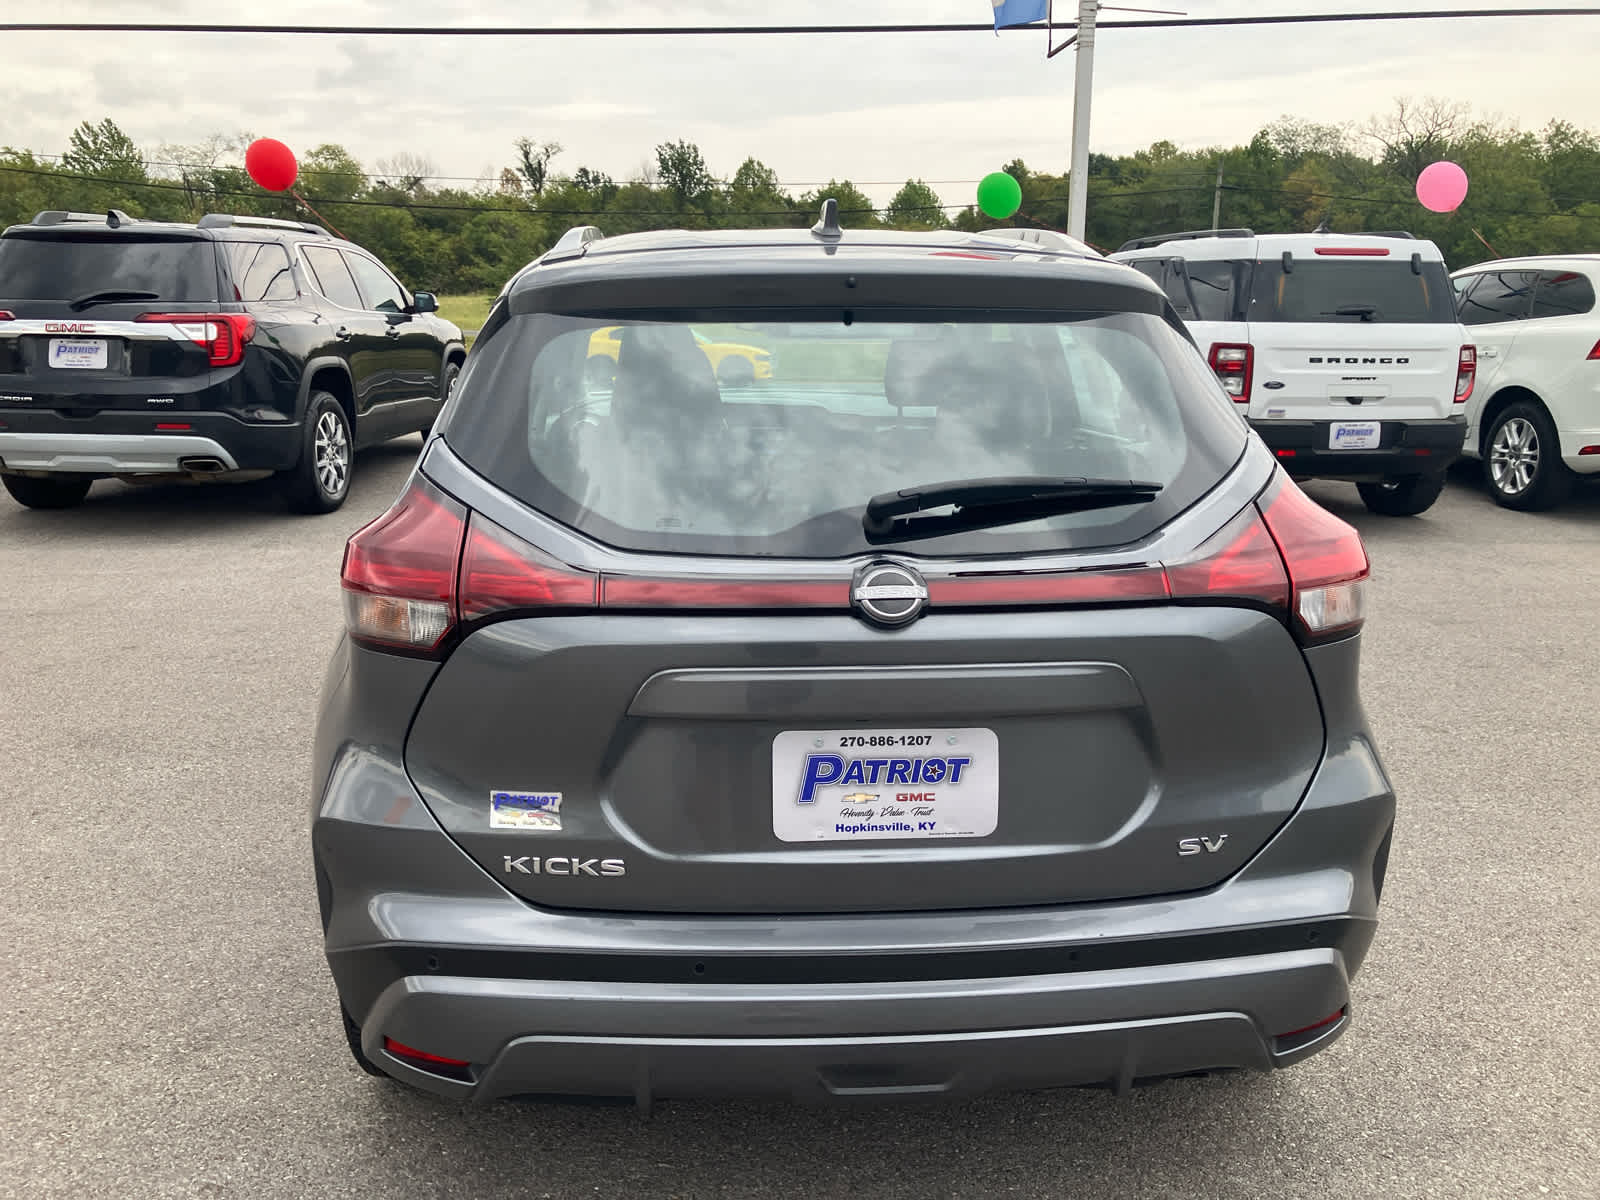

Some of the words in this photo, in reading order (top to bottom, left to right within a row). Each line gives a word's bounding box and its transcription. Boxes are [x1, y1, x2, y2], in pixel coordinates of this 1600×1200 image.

[45, 323, 96, 333] GMC
[855, 586, 927, 599] NISSAN
[839, 735, 932, 748] 270-886-1207
[798, 753, 971, 804] PATRIOT
[494, 792, 559, 811] PATRIOT
[895, 792, 936, 802] GMC
[910, 806, 935, 817] Trust
[835, 822, 914, 834] Hopkinsville,
[918, 821, 936, 831] KY
[1179, 834, 1228, 856] SV
[503, 855, 625, 876] KICKS
